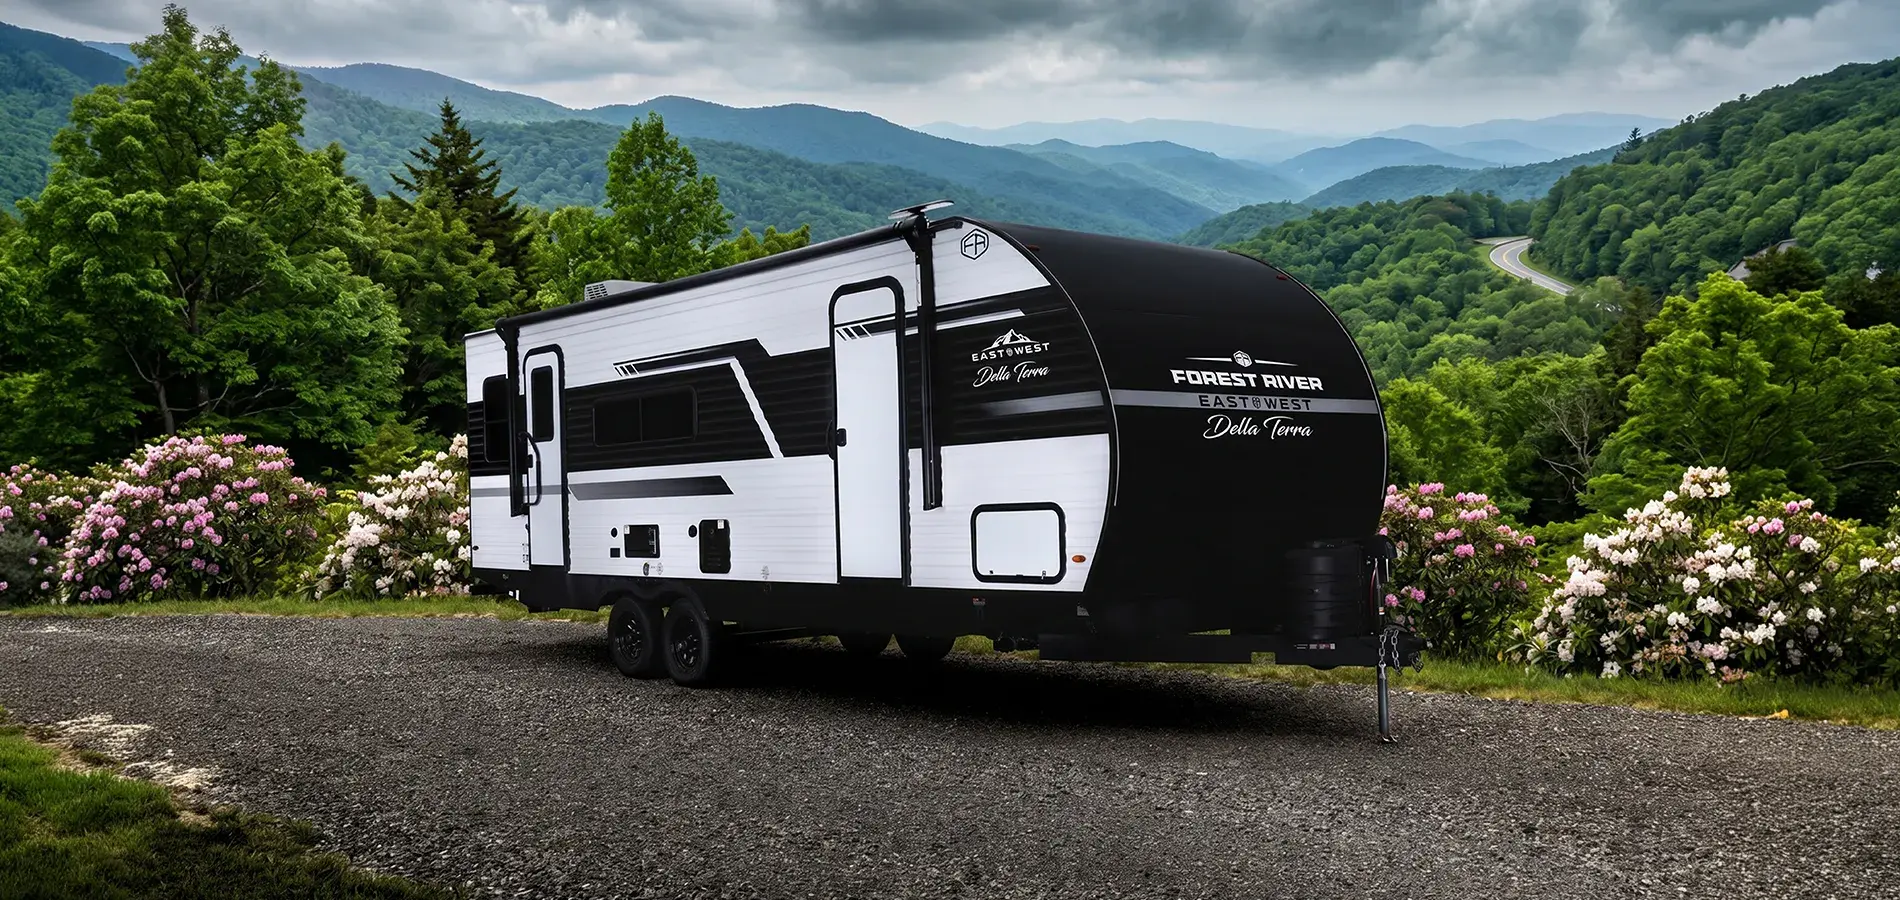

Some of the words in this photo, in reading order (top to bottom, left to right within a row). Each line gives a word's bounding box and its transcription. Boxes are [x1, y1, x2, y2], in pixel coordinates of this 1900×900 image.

[971, 349, 1004, 362] EAST
[1014, 342, 1050, 355] WEST
[972, 366, 1011, 388] Della
[1013, 360, 1050, 383] Terra
[1169, 369, 1258, 387] FOREST
[1260, 373, 1324, 391] RIVER
[1198, 394, 1249, 408] EAST
[1263, 397, 1312, 411] WEST
[1202, 414, 1261, 440] Della
[1262, 415, 1314, 440] Terra
